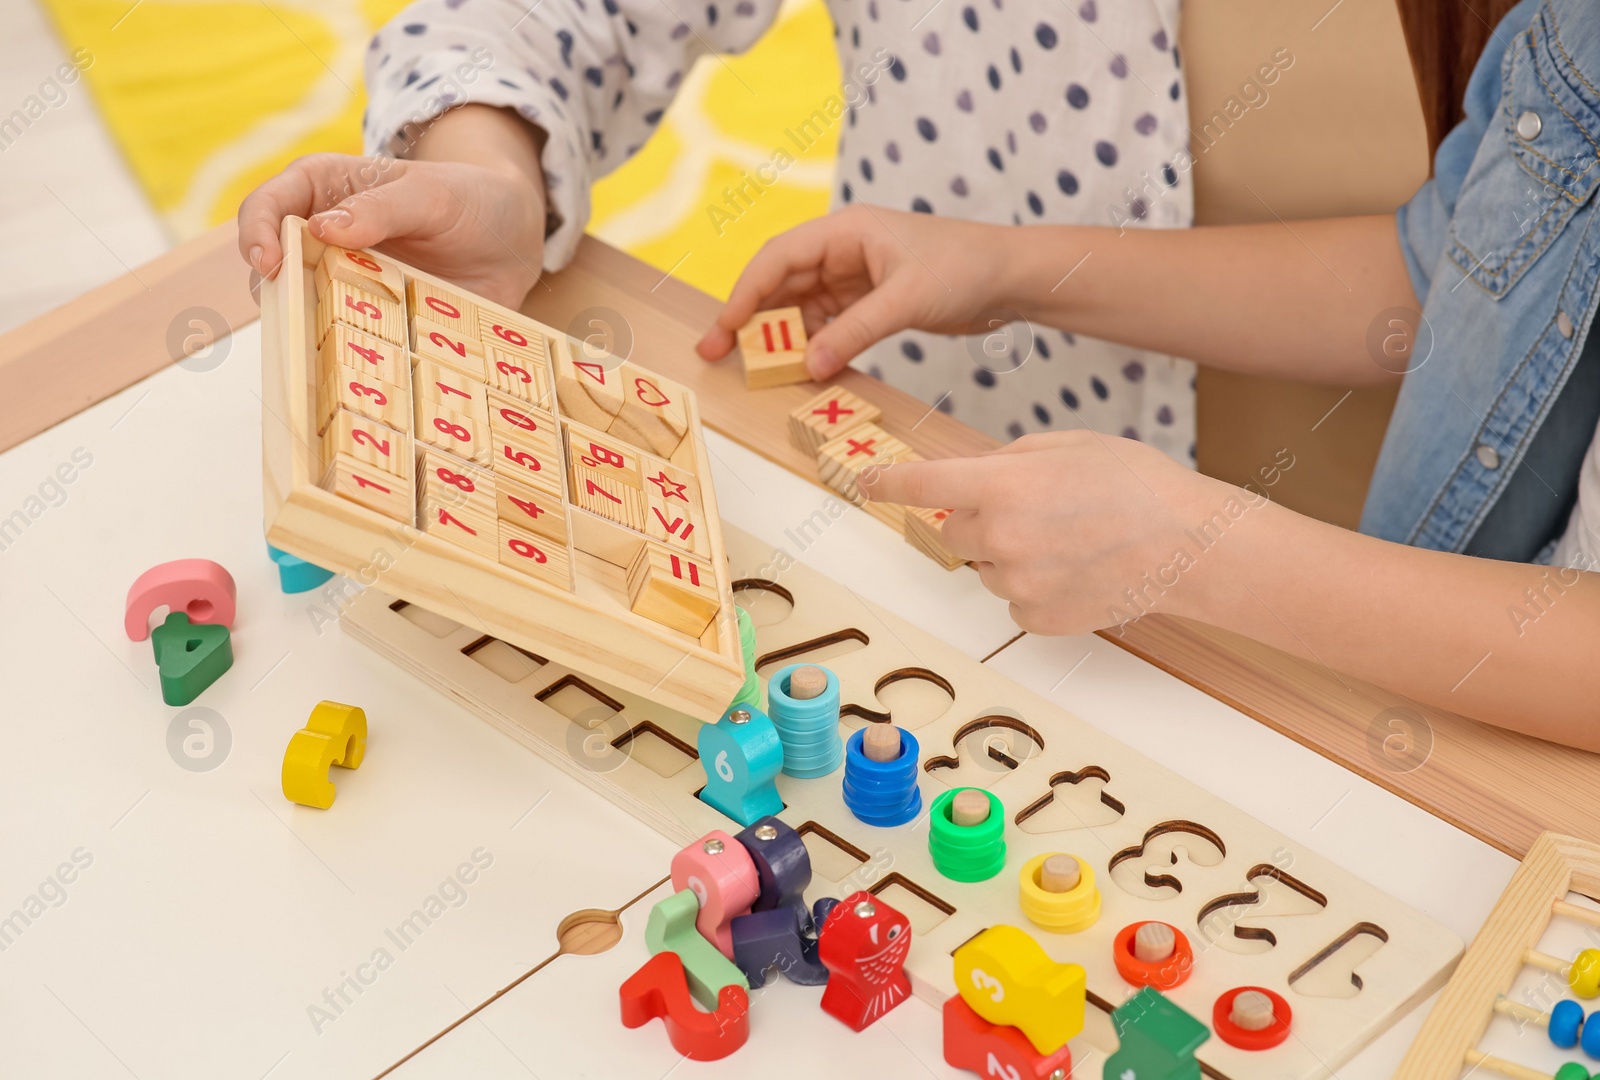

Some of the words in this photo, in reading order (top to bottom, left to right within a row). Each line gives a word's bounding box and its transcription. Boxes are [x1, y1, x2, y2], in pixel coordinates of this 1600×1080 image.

[346, 252, 383, 273] 6
[345, 294, 383, 320] 5
[425, 296, 461, 319] 0
[429, 331, 467, 358] 2
[492, 324, 528, 347] 6
[347, 341, 385, 366] 4
[496, 361, 533, 384] 3
[349, 381, 388, 406] 3
[435, 381, 472, 400] 1
[433, 417, 472, 443] 8
[499, 408, 538, 432] 0
[352, 429, 391, 457] 2
[504, 445, 542, 472] 5
[352, 474, 391, 494] 1
[436, 467, 476, 493] 8
[585, 479, 623, 505] 7
[508, 495, 545, 519] 4
[438, 508, 478, 537] 7
[507, 539, 548, 565] 9
[714, 749, 735, 783] 6
[970, 968, 1005, 1003] 3
